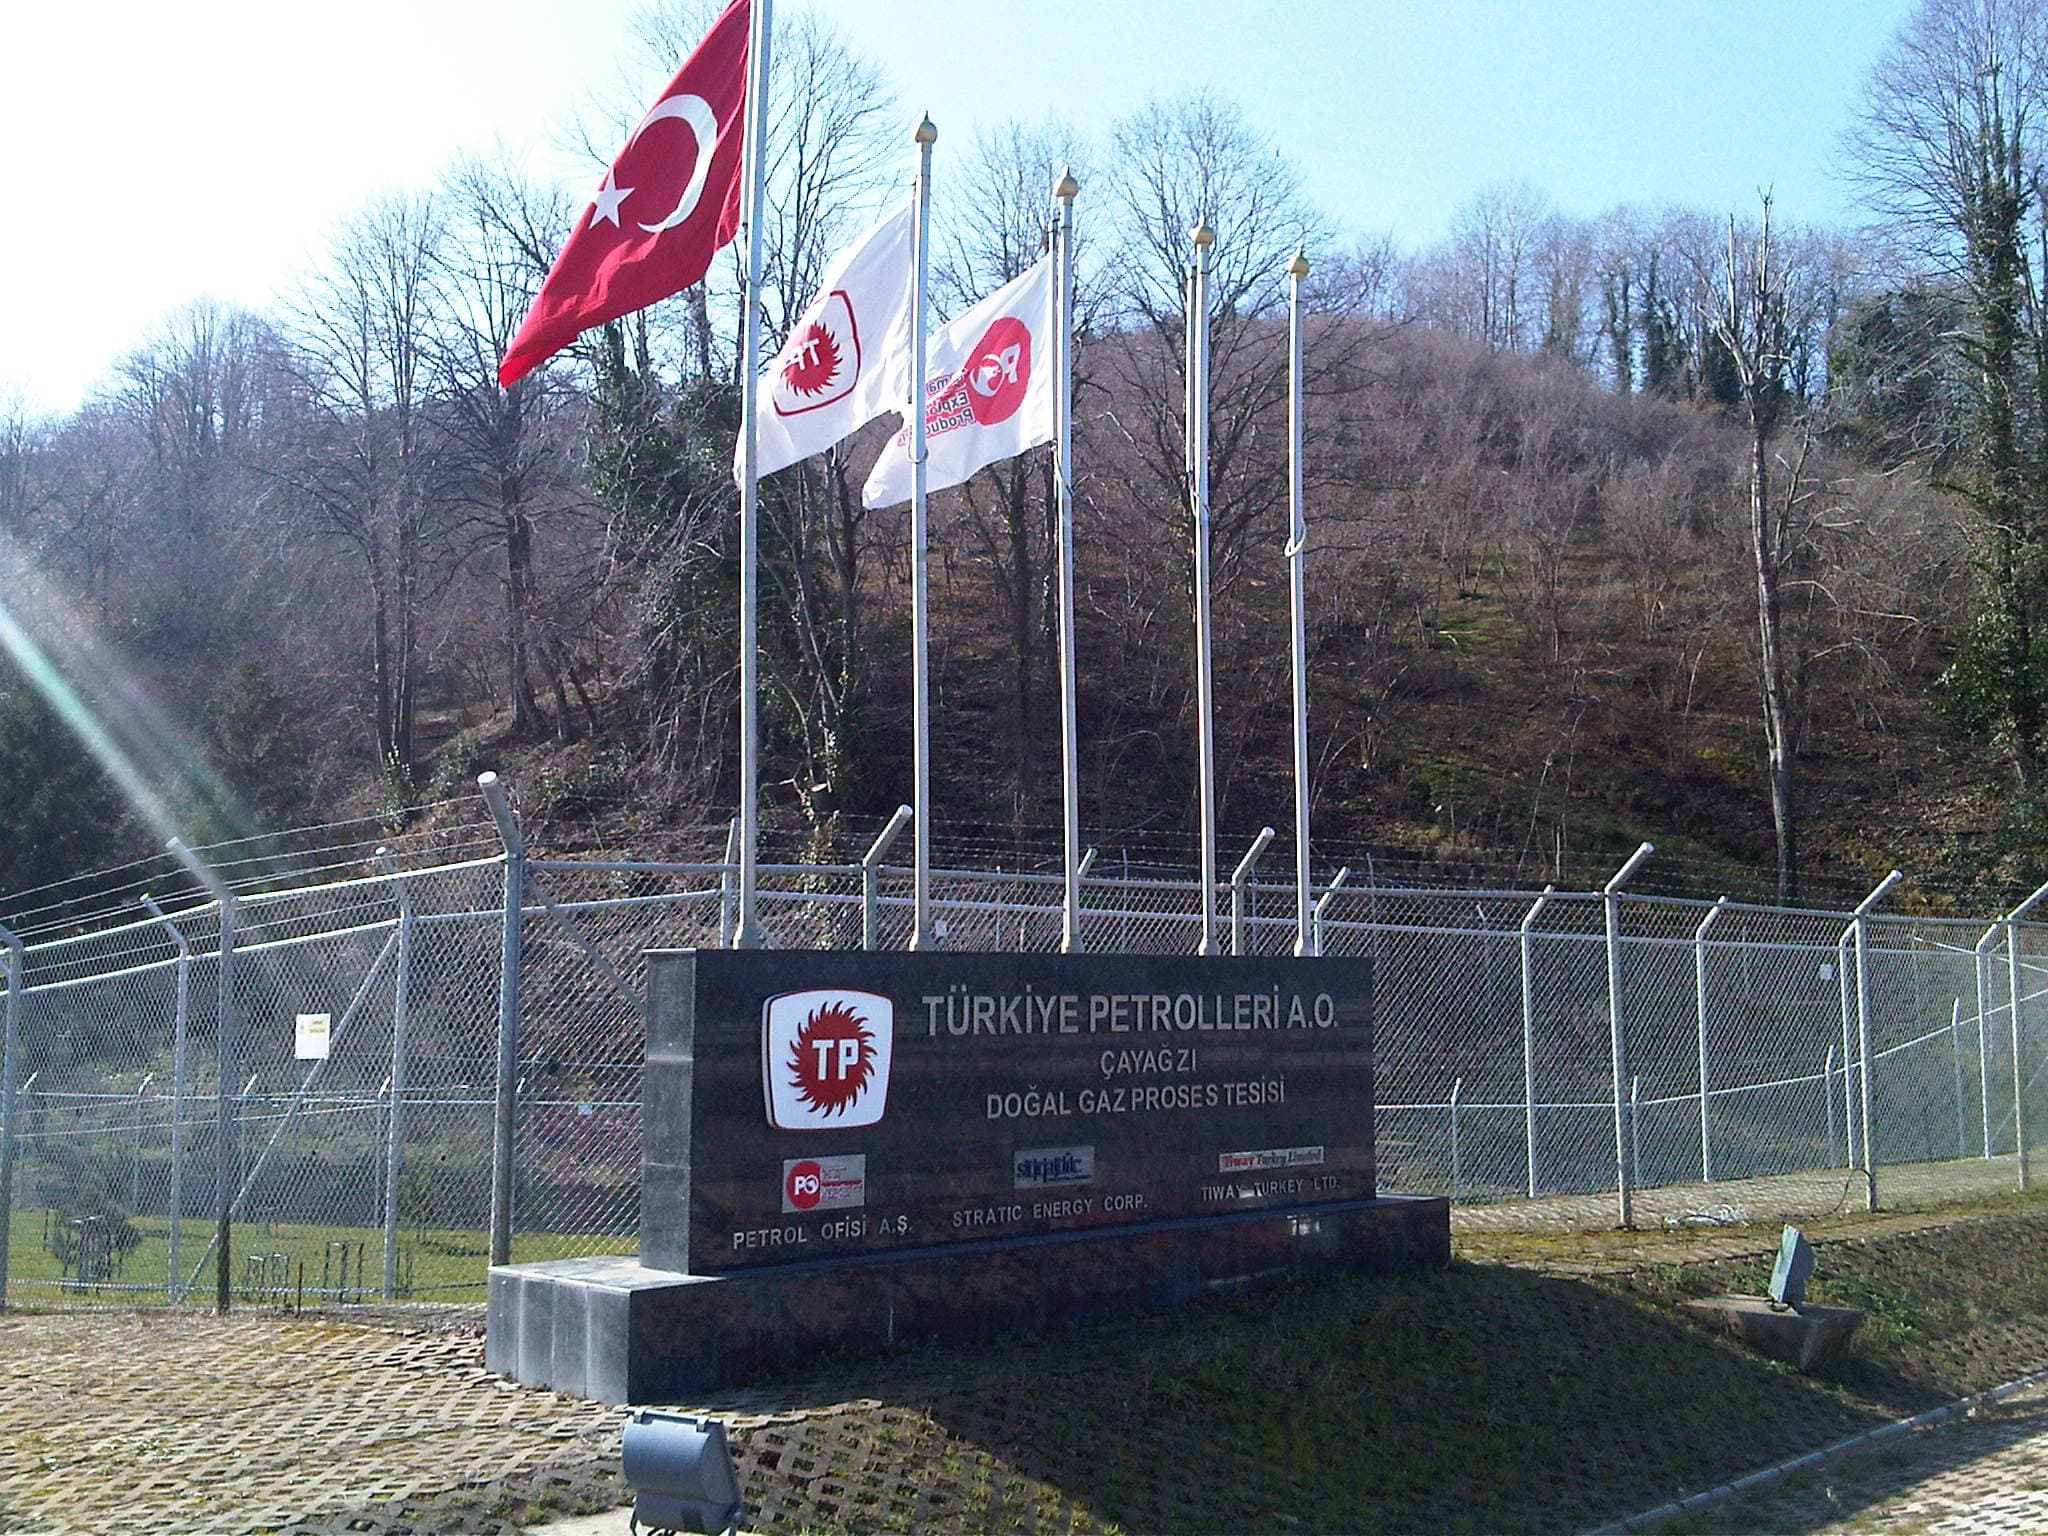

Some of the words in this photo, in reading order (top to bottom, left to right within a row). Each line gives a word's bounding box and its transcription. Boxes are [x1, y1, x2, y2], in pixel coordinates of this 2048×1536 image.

[922, 984, 1079, 1036] TÜRKİYE
[1089, 984, 1280, 1033] PETROLLERİ
[1286, 992, 1339, 1030] A.O.
[812, 1039, 859, 1080] TP
[1100, 1042, 1197, 1080] ÇAYAĞZI
[986, 1083, 1071, 1119] DOĞAL
[1078, 1089, 1126, 1114] GAZ
[1131, 1083, 1218, 1111] PROSES
[1223, 1074, 1285, 1106] TESİSİ
[1200, 1183, 1244, 1201] TIWAY
[1254, 1179, 1304, 1197] TURKEY
[953, 1205, 1022, 1227] STRATIC
[1033, 1199, 1093, 1219] ENERGY
[1104, 1193, 1149, 1212] CORP.
[733, 1226, 807, 1250] PETROL
[821, 1214, 867, 1240] OFİSİ
[879, 1215, 913, 1237] A.Ş.
